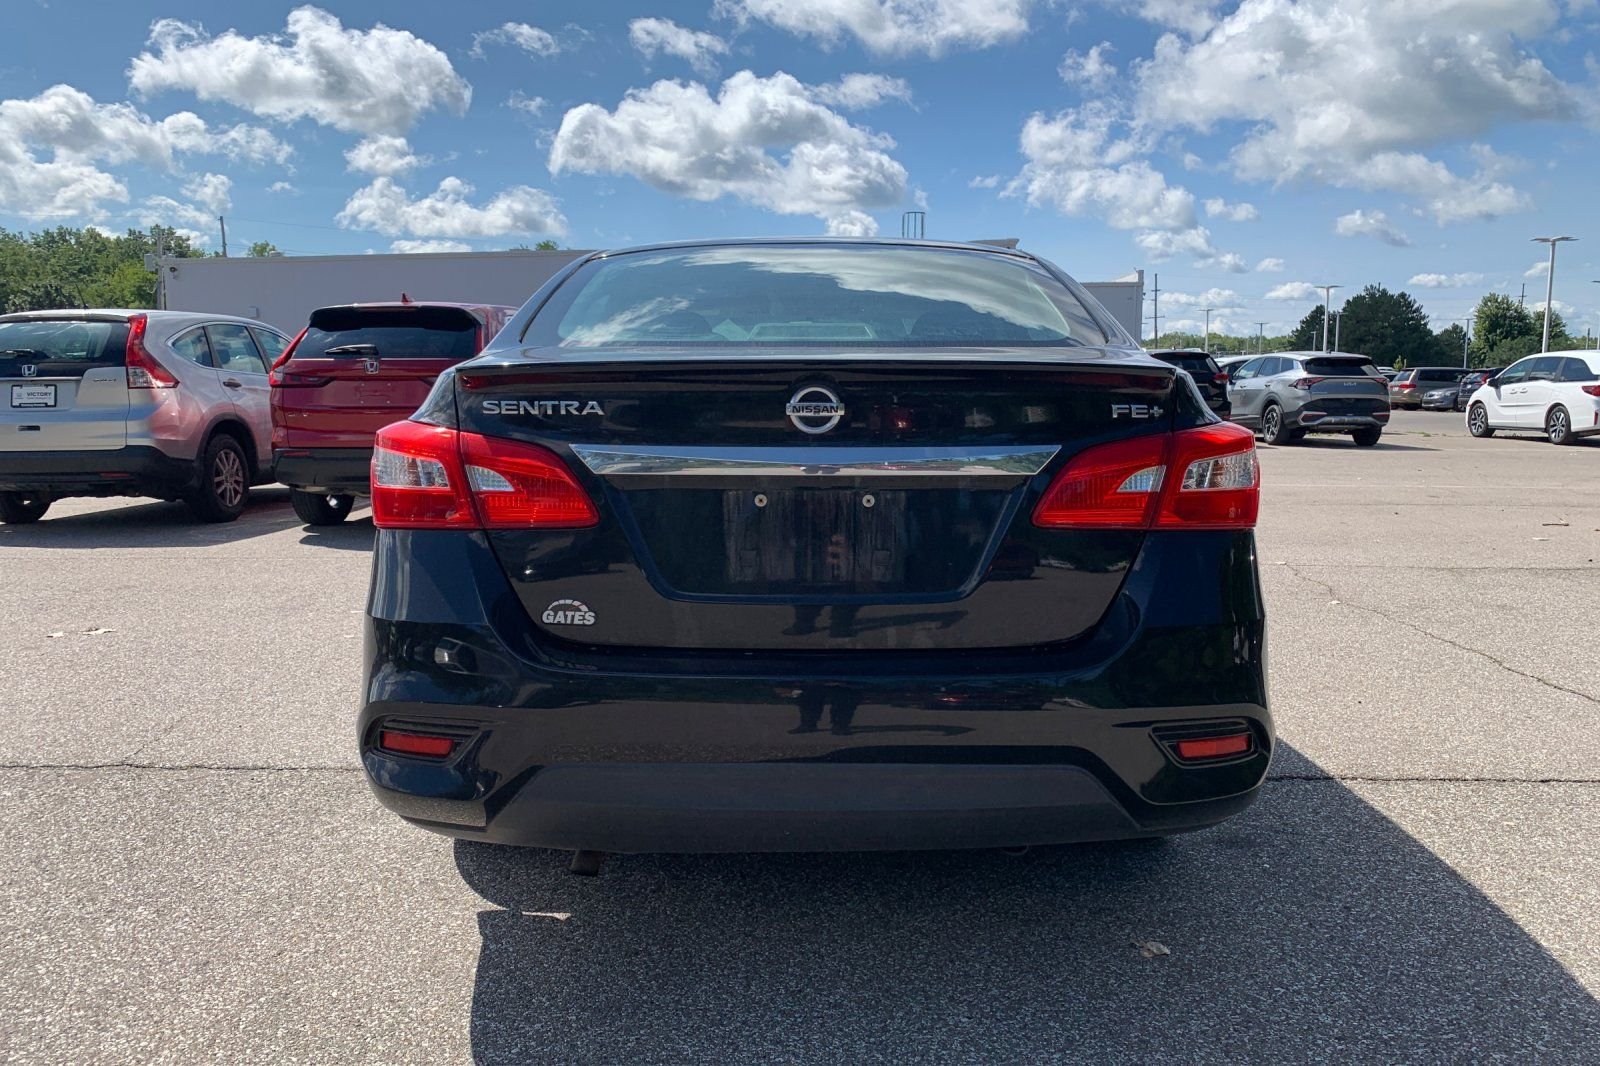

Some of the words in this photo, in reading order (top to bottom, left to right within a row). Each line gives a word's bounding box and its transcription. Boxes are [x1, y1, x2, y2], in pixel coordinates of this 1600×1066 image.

[482, 400, 605, 416] SENTRA
[791, 405, 839, 414] NISSAN
[1111, 404, 1164, 419] FE+
[542, 610, 596, 625] GATES
